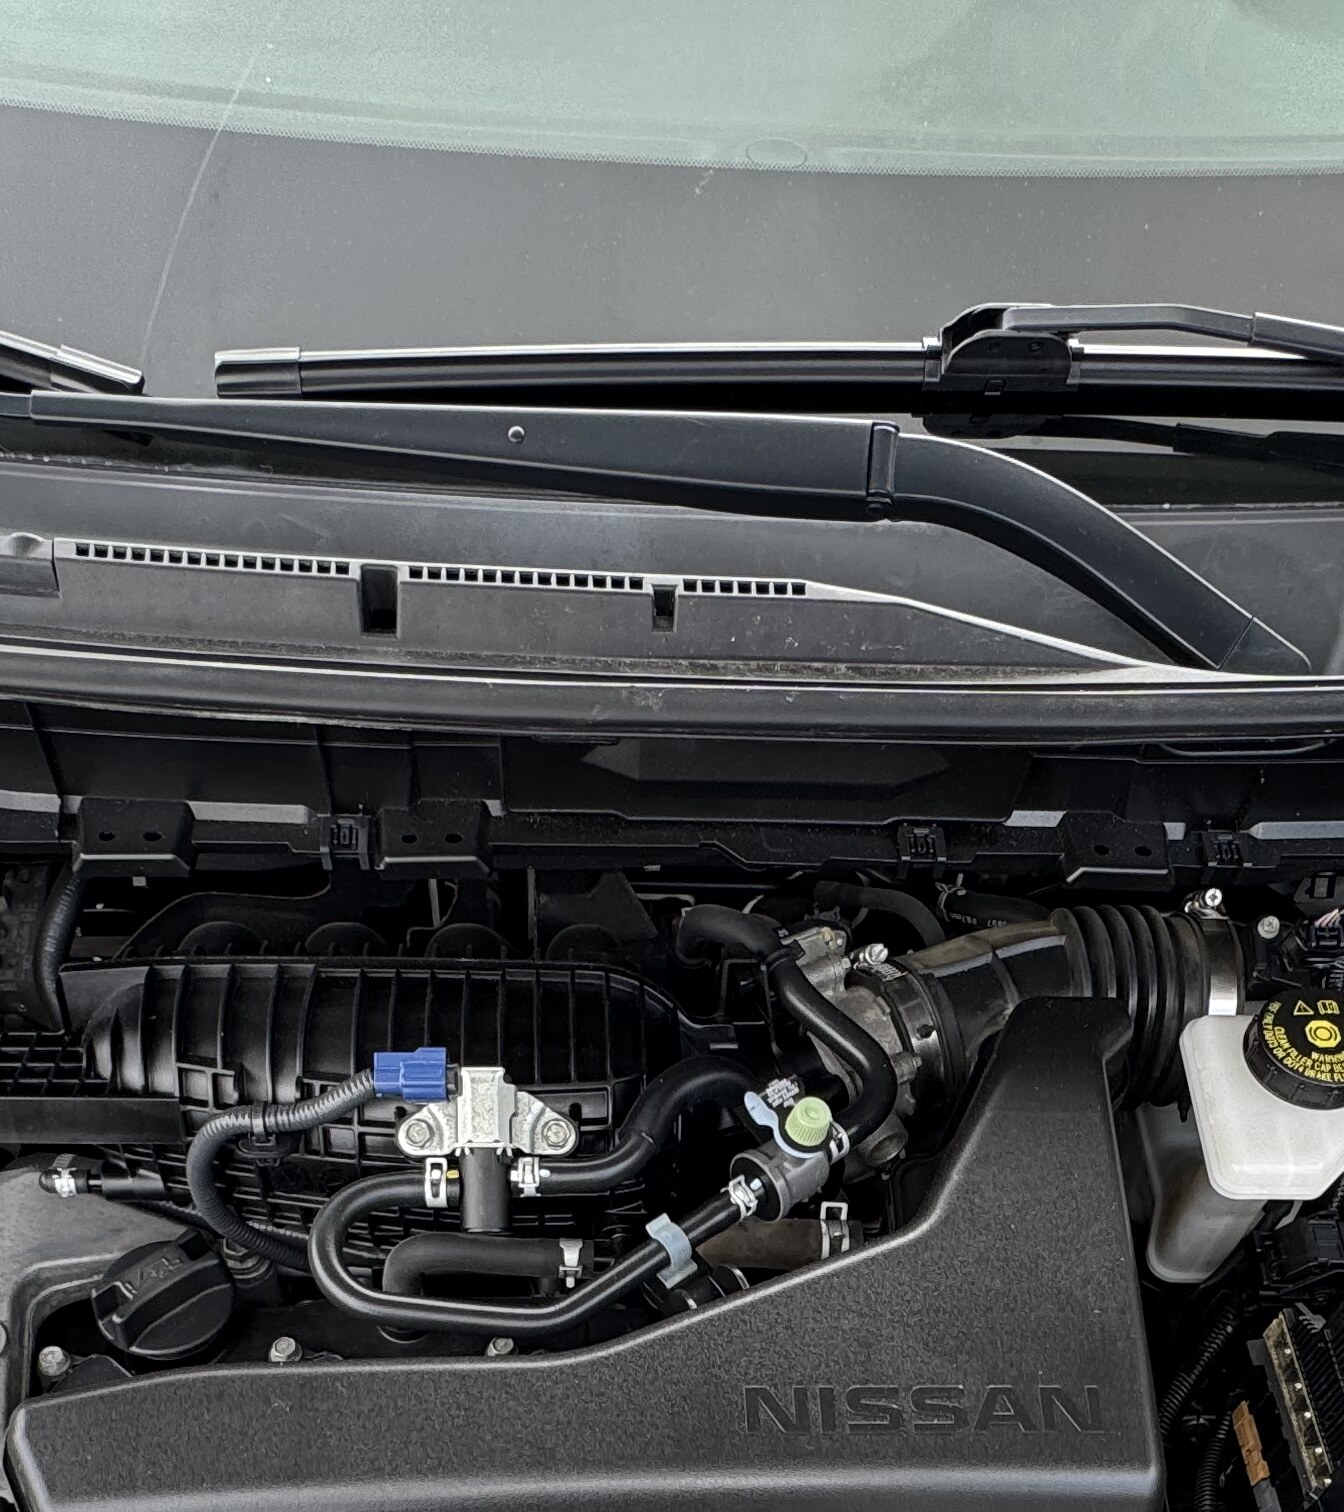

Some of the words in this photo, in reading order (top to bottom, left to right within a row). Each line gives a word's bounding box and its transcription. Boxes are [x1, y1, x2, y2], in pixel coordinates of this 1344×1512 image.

[1274, 1026, 1291, 1051] CLEAN
[1286, 1048, 1313, 1067] FILLER
[1314, 1062, 1332, 1073] CAP
[1304, 1070, 1333, 1083] BRAKE
[743, 1384, 1099, 1434] NISSAN
